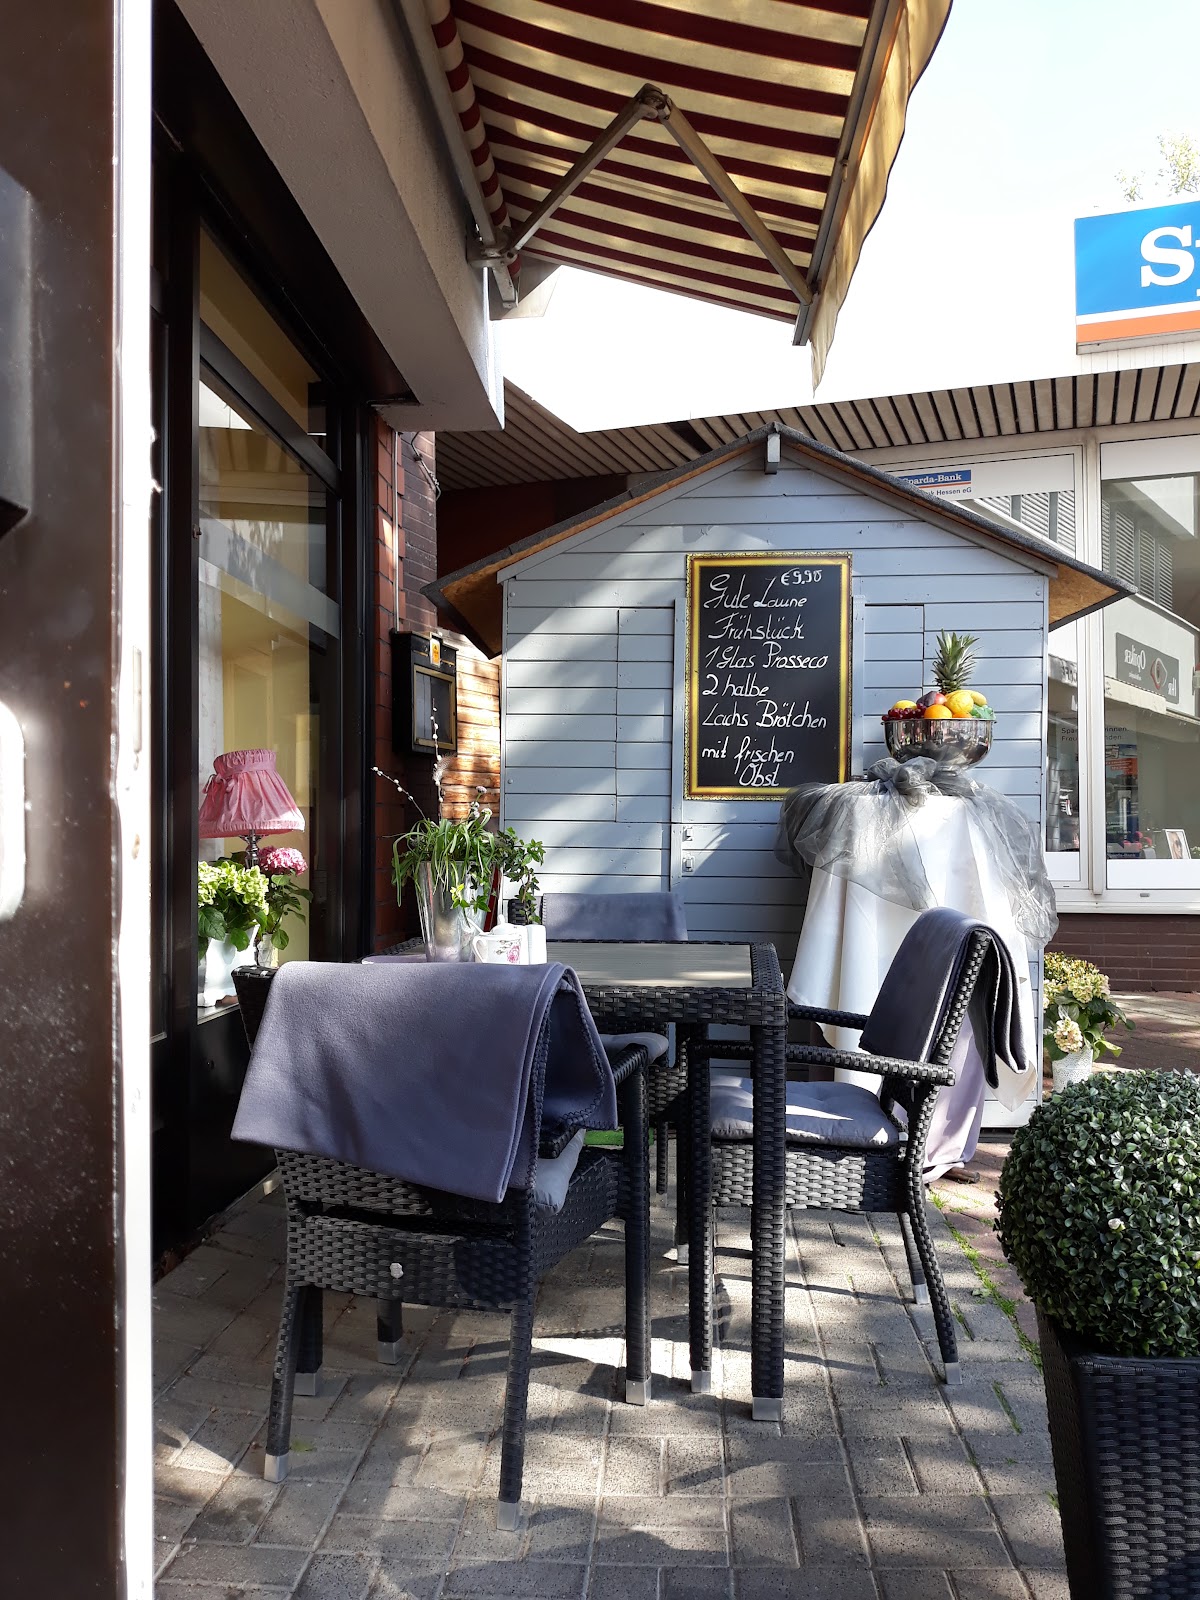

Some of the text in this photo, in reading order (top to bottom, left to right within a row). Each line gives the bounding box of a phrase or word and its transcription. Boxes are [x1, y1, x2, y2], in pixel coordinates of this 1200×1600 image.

[936, 488, 961, 496] Hessen
[703, 573, 808, 609] Gute Laune
[708, 612, 804, 639] Frühstück
[719, 645, 756, 669] Glas
[702, 673, 770, 697] 2 halbe
[701, 699, 827, 729] Lachs Brötchen
[701, 735, 795, 775] mit frischen
[738, 763, 780, 787] Obst
